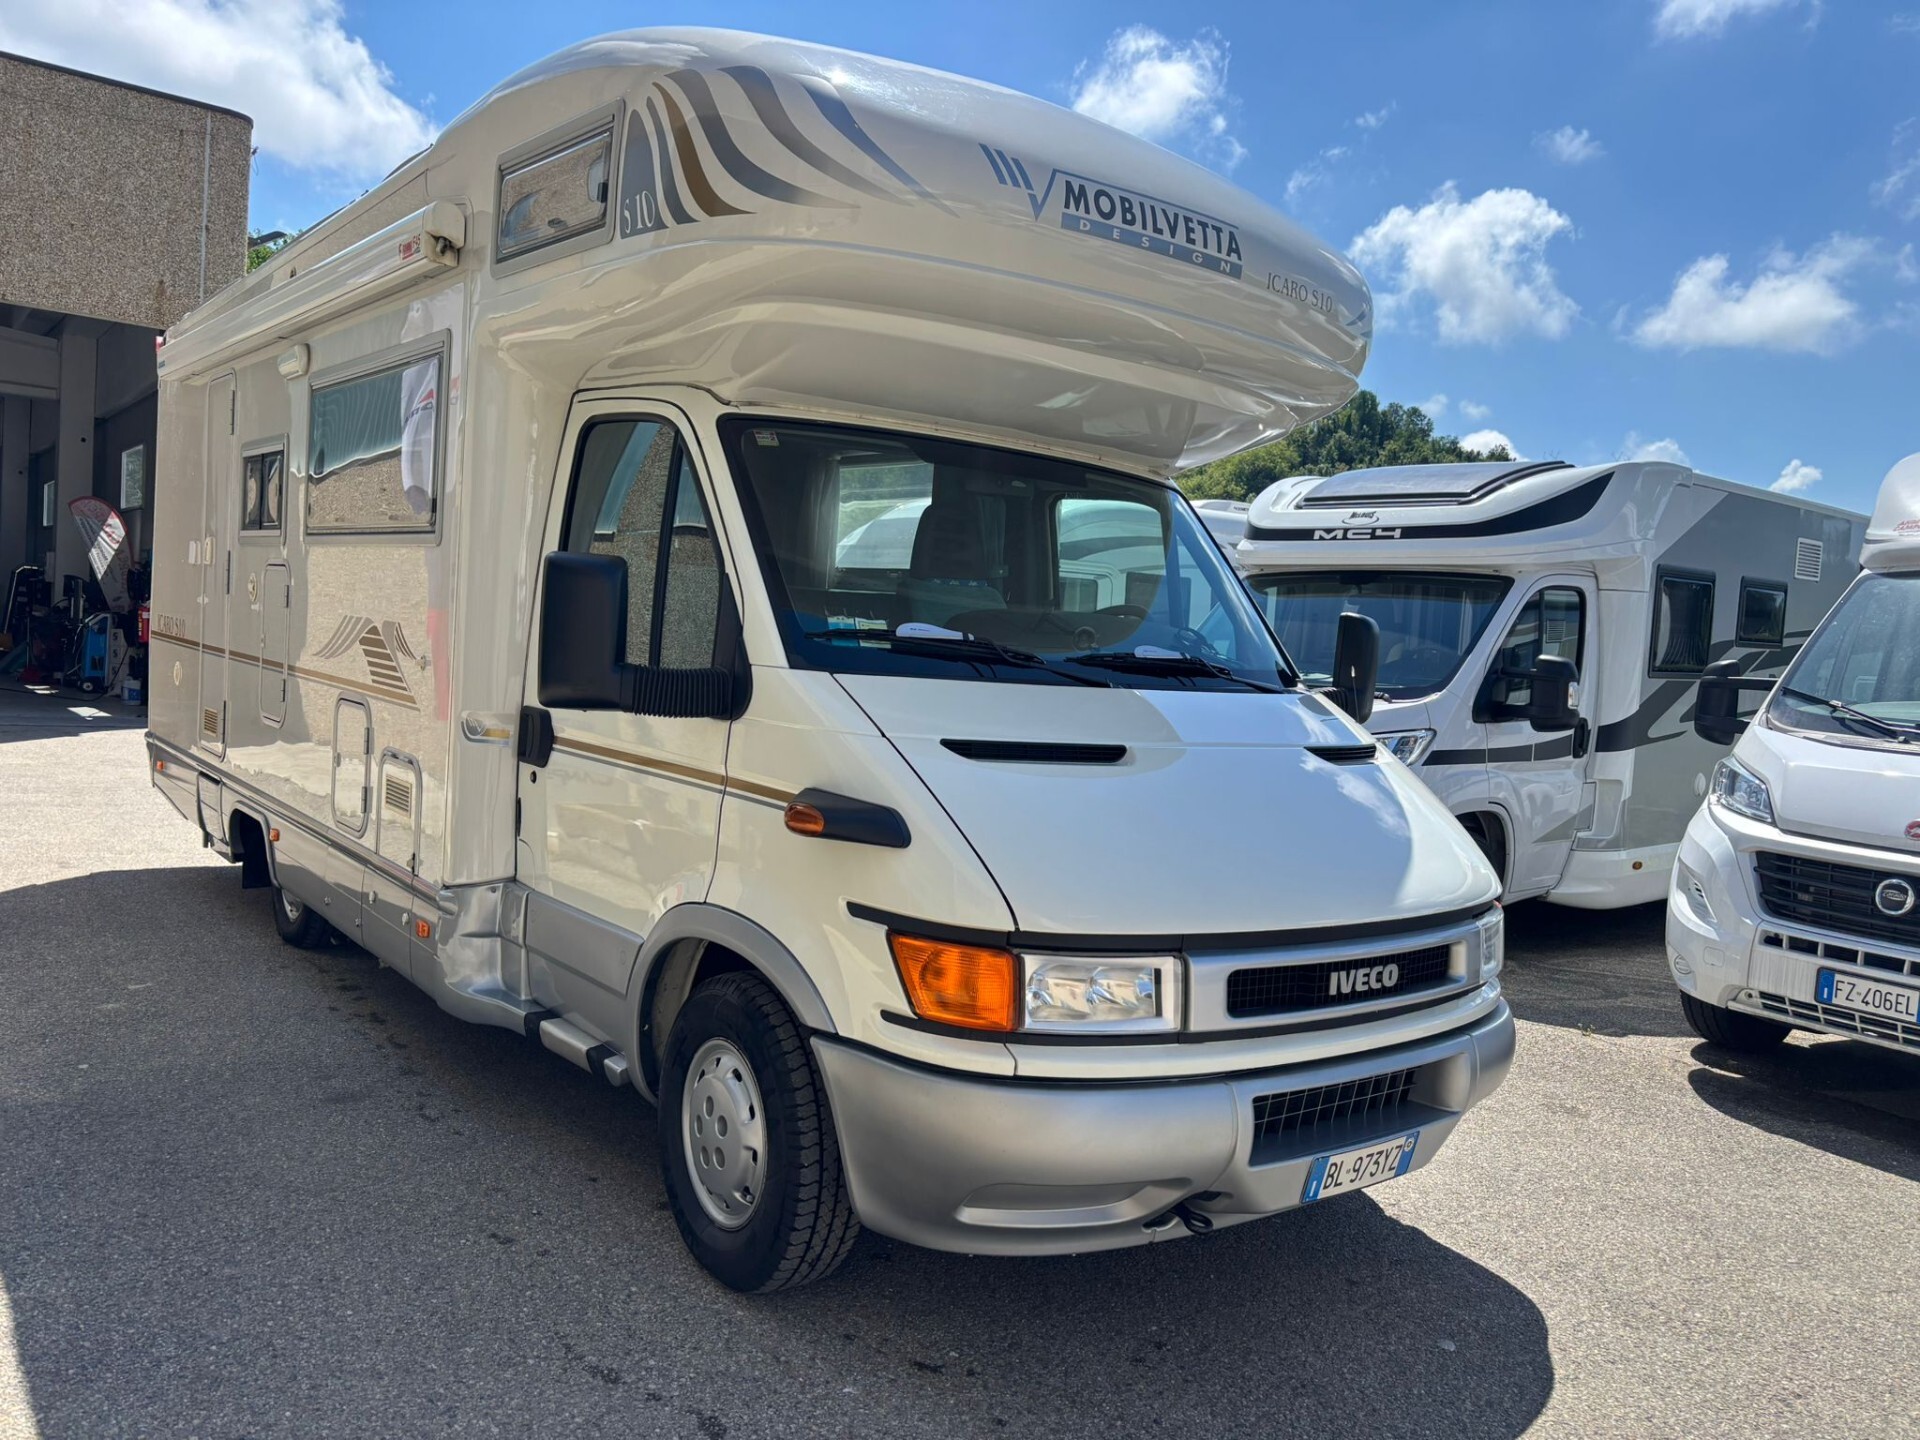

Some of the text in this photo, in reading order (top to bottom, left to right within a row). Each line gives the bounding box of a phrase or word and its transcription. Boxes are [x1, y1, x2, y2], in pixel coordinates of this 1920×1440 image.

[1063, 179, 1243, 261] MOBILVETTA
[1079, 219, 1231, 273] DESIGN
[1266, 272, 1333, 313] ICARO S10
[1313, 528, 1402, 540] MC4
[1328, 963, 1399, 996] IVECO
[1834, 980, 1857, 1002] FZ
[1860, 987, 1915, 1017] 406EL
[1322, 1161, 1344, 1190] BL
[1349, 1144, 1403, 1184] 973YZ
